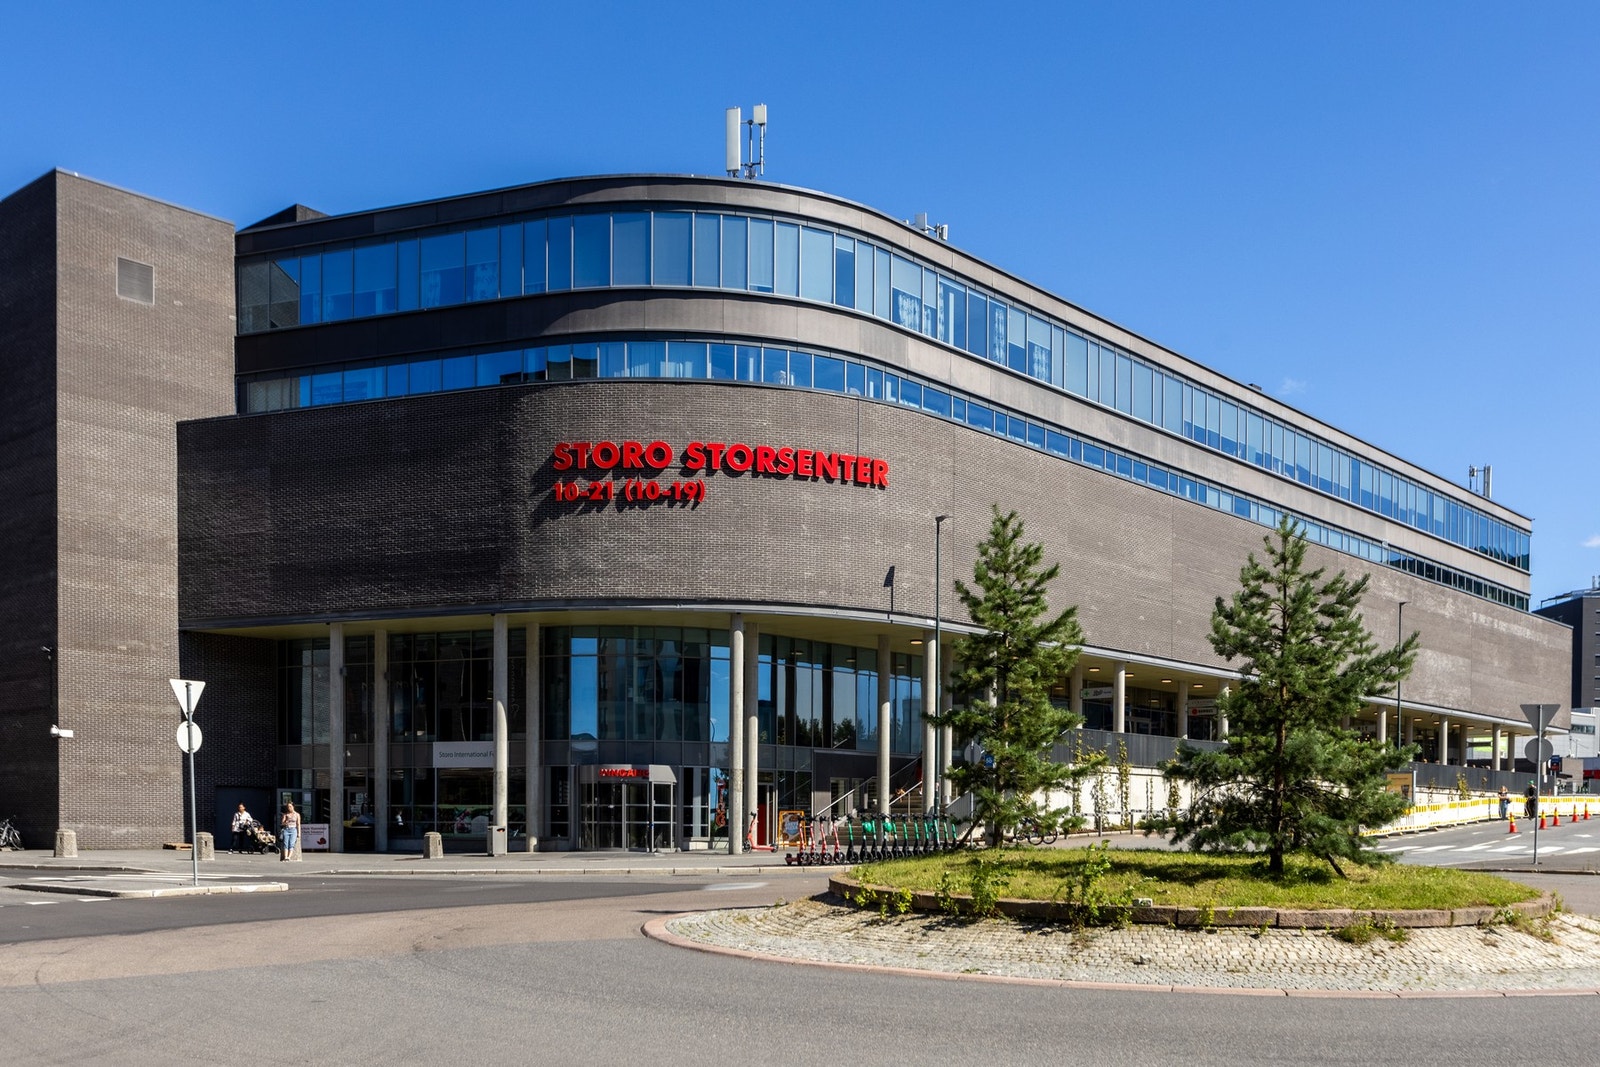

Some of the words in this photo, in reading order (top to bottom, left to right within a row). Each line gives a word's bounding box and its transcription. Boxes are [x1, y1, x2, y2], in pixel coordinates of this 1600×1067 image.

[553, 441, 673, 470] STORO
[685, 441, 889, 487] STORSENTER
[554, 480, 614, 501] 10-21
[625, 478, 706, 503] (10-19)
